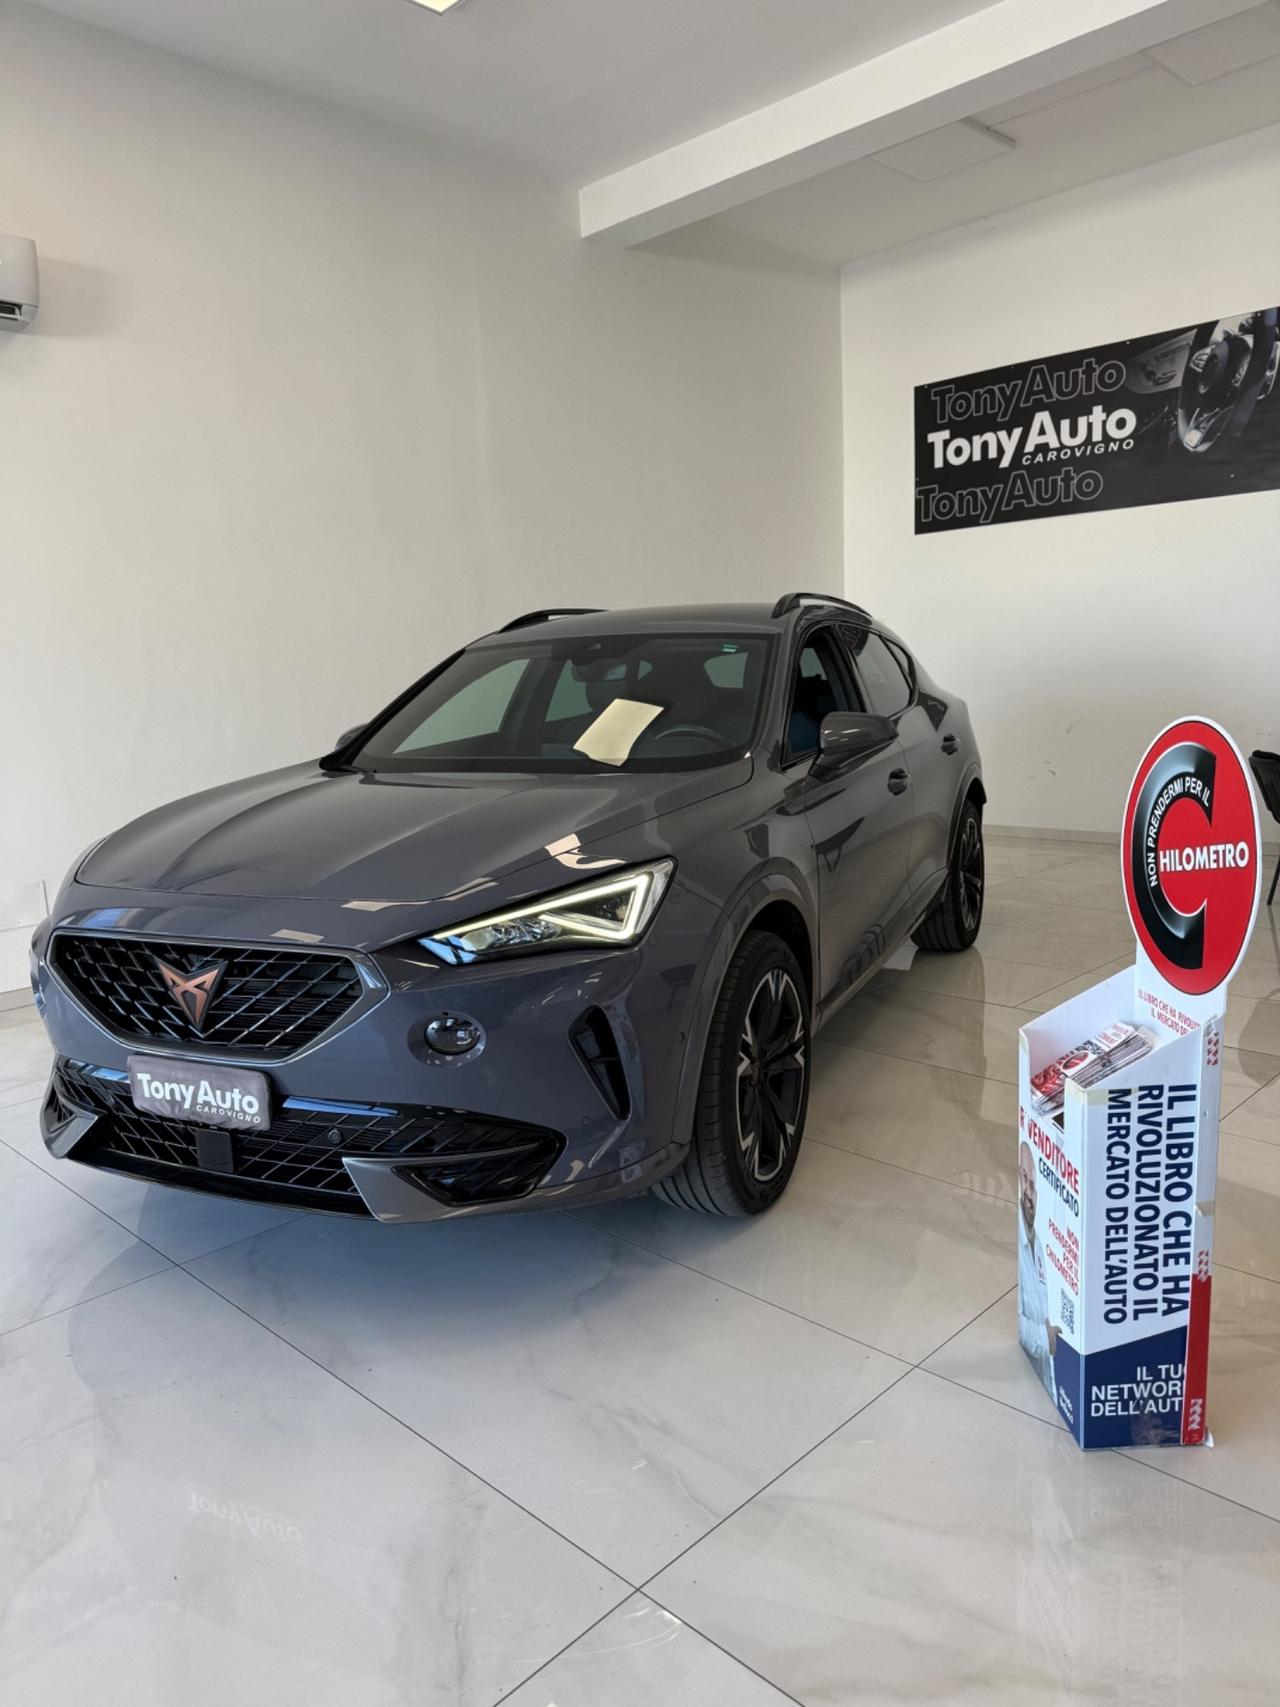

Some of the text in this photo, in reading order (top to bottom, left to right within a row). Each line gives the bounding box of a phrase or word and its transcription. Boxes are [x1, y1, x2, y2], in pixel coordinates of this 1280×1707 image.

[927, 405, 1137, 469] Tony Auto
[1022, 438, 1135, 466] CAROVIGNO
[1147, 777, 1210, 887] NON PRENDERMI PER IL
[137, 1073, 259, 1114] Tony Auto
[196, 1104, 261, 1124] CAROVIGNO
[1038, 1157, 1079, 1217] CERTIFICATO
[1103, 1088, 1132, 1325] MERCATO DELL'AUTO
[1132, 1084, 1164, 1321] RIVOLUZIONATO IL
[1161, 1084, 1197, 1317] IL LIBRO CHE HA
[1091, 1380, 1184, 1401] NETWOR
[1137, 1366, 1153, 1381] IL
[1091, 1397, 1183, 1417] DELL'AUT
